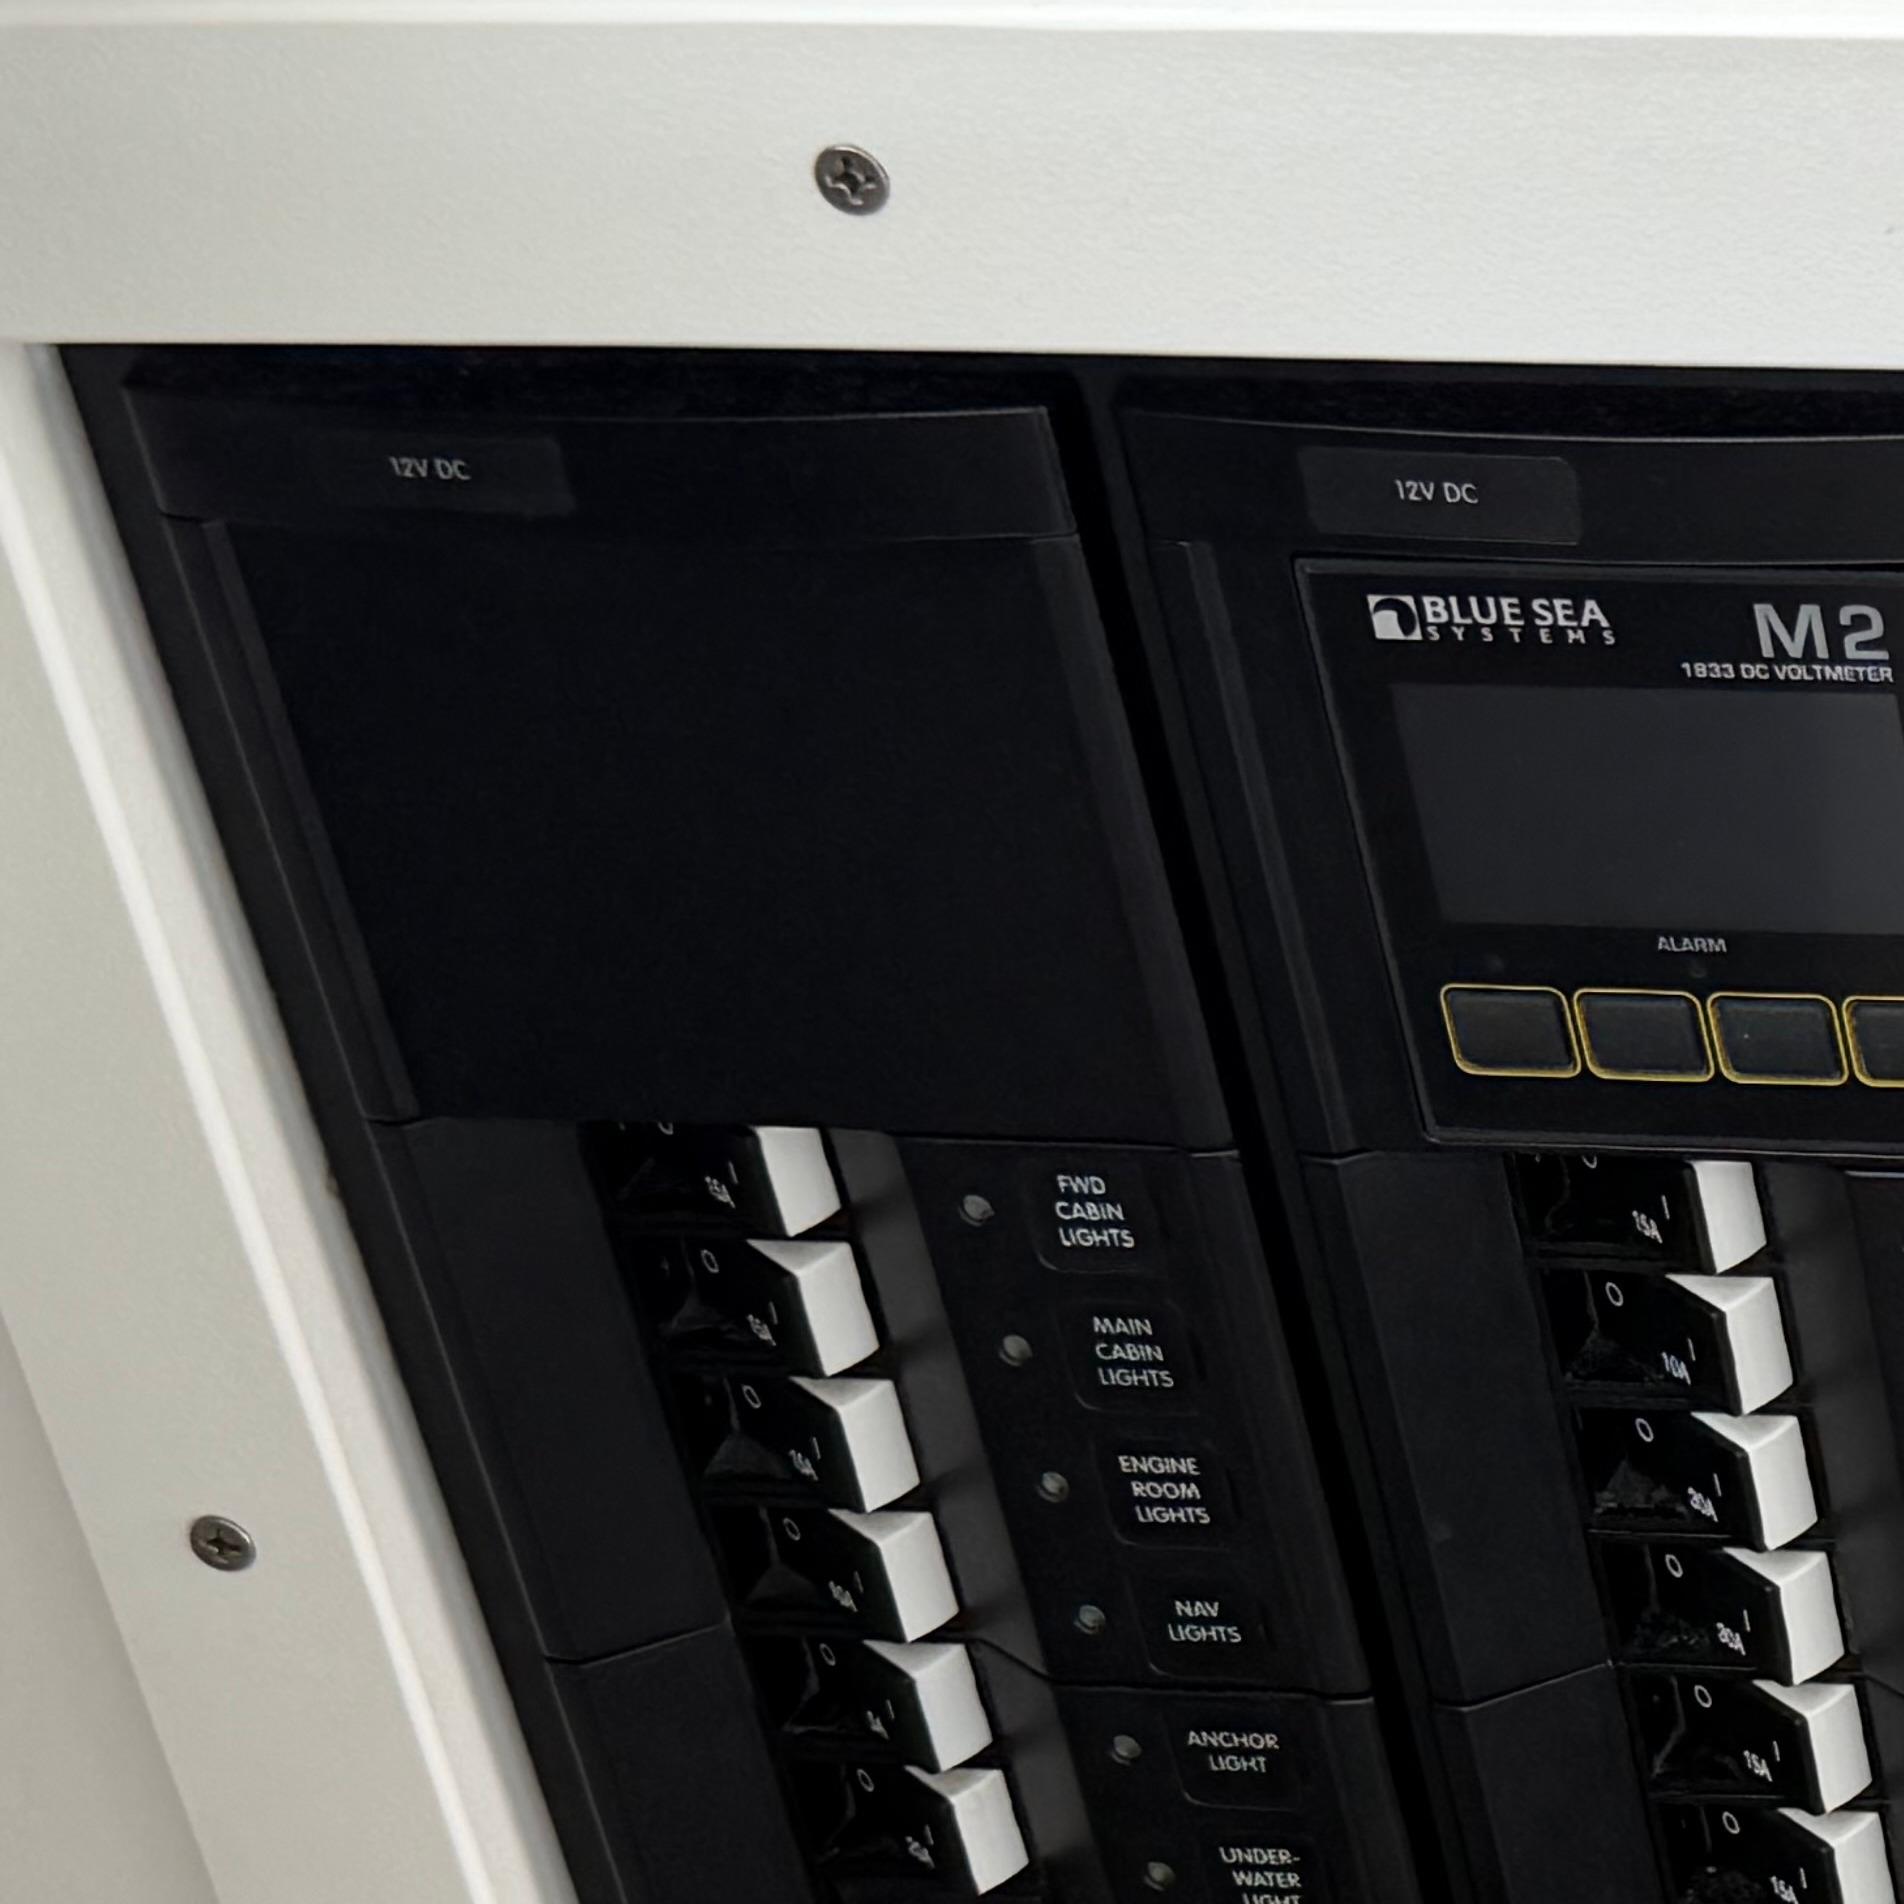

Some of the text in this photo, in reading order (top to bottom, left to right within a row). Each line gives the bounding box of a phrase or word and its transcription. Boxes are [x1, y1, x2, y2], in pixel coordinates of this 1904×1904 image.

[389, 457, 470, 480] 12V DC
[1396, 480, 1478, 503] 12V DC
[1422, 596, 1609, 627] BLUE SEA
[1427, 626, 1615, 644] SYSTEMS
[1754, 604, 1889, 660] M2
[1682, 662, 1893, 682] 1833 DC VOLTMETER
[1658, 936, 1726, 952] ALARM
[1057, 1175, 1105, 1194] FWD
[1055, 1201, 1124, 1220] CABIN
[1059, 1228, 1134, 1248] LIGHTS
[1093, 1317, 1152, 1335] MAIN
[1096, 1343, 1163, 1361] CABIN
[1098, 1368, 1174, 1387] LIGHTS
[1118, 1456, 1200, 1475] ENGINE
[1131, 1481, 1200, 1499] ROOM
[1135, 1506, 1210, 1523] LIGHTS
[1175, 1601, 1219, 1617] NAV
[1168, 1624, 1241, 1642] LIGHTS
[1188, 1731, 1279, 1749] ANCHOR
[1209, 1755, 1266, 1772] LIGHT
[1219, 1847, 1300, 1865] UNDER-
[1232, 1871, 1301, 1888] WATER
